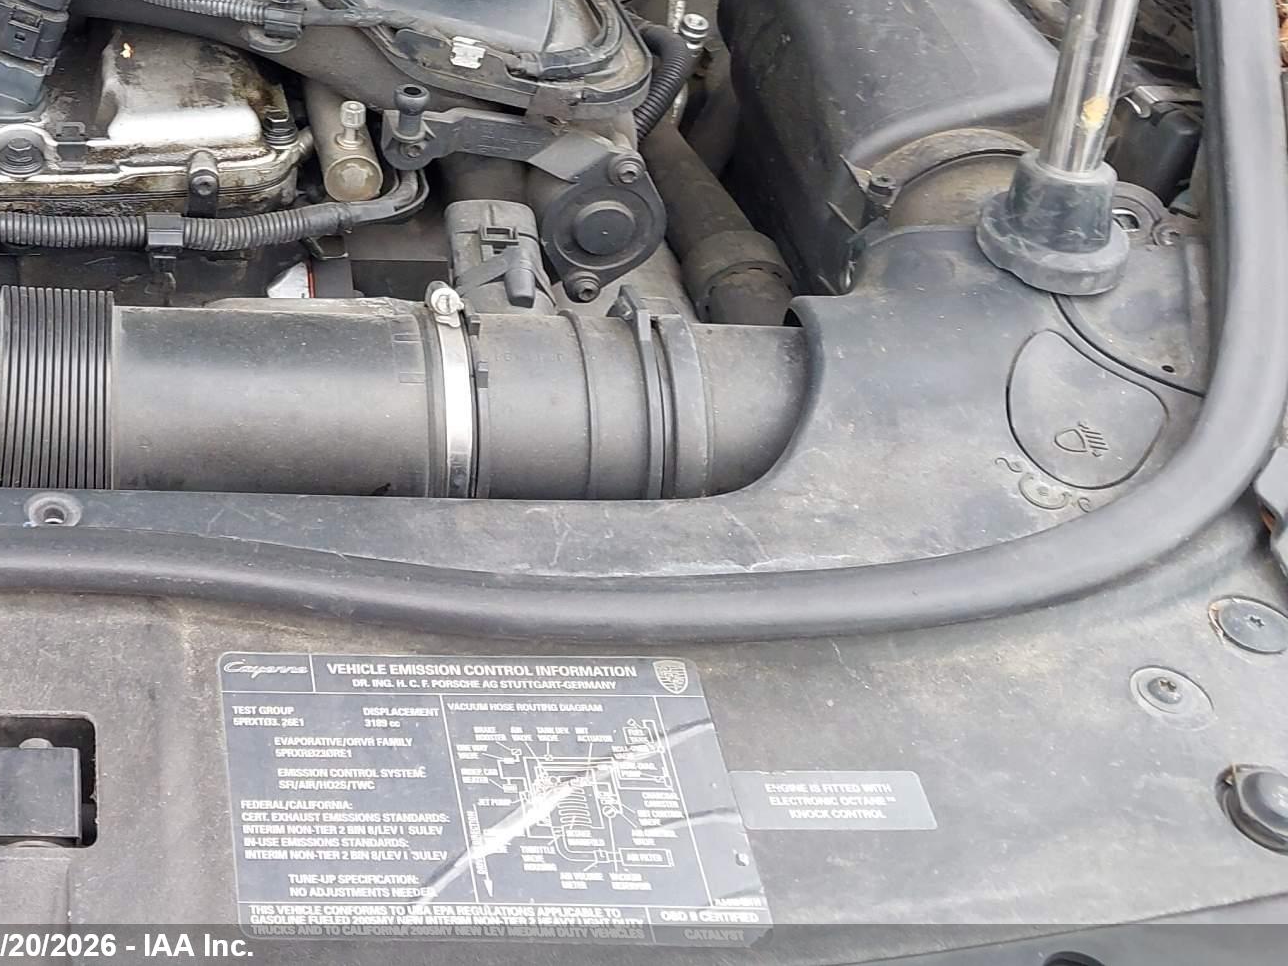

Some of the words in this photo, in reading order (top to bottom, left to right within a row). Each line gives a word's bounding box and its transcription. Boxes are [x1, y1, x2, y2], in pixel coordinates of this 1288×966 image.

[327, 664, 387, 675] VEHICLE
[390, 664, 462, 676] EMISSION
[465, 665, 533, 676] CONTROL
[536, 666, 637, 677] INFORMATION
[352, 679, 371, 687] DR.
[372, 679, 393, 688] ING.
[431, 679, 480, 688] PORSCHE
[482, 679, 497, 689] AG
[233, 706, 257, 715] TEST
[258, 706, 294, 715] GROUP
[363, 708, 439, 716] DISPLACEMENT
[447, 703, 489, 711] VACUUM
[491, 703, 515, 711] HOSE
[516, 703, 554, 712] ROUTING
[557, 704, 603, 712] DIAGRAM
[376, 738, 413, 747] FAMILY
[277, 769, 328, 778] EMISSION
[329, 769, 379, 778] CONTROL
[810, 784, 821, 793] IS
[821, 784, 860, 793] FITTED
[861, 784, 892, 793] WITH
[769, 796, 840, 806] ELECTRONIC
[241, 813, 269, 822] CERT.
[271, 813, 320, 822] EXHAUST
[323, 813, 381, 822] EMISSIONS
[383, 813, 450, 823] STANDARDS:
[789, 809, 831, 819] KNOCK
[831, 809, 887, 819] CONTROL
[243, 825, 285, 835] INTERIM
[287, 825, 337, 835] NON-TIER
[339, 826, 345, 835] 2
[408, 826, 443, 835] SULEV
[244, 838, 279, 847] IN-USE
[280, 838, 340, 847] EMISSIONS
[341, 838, 409, 848] STANDARDS:
[245, 850, 287, 860] INTERIM
[289, 850, 341, 860] NON-TIER
[342, 851, 349, 860] 2
[288, 875, 337, 884] TUNE-UP
[338, 875, 419, 884] SPECIFICATION:
[289, 888, 307, 897] NO
[309, 888, 390, 897] ADJUSTMENTS
[249, 905, 274, 915] THIS
[275, 905, 322, 915] VEHICLE
[323, 905, 387, 915] CONFORMS
[388, 906, 406, 915] TO
[456, 906, 535, 916] REGULATIONS
[604, 908, 621, 918] TO
[296, 925, 322, 935] AND
[324, 926, 339, 935] TO
